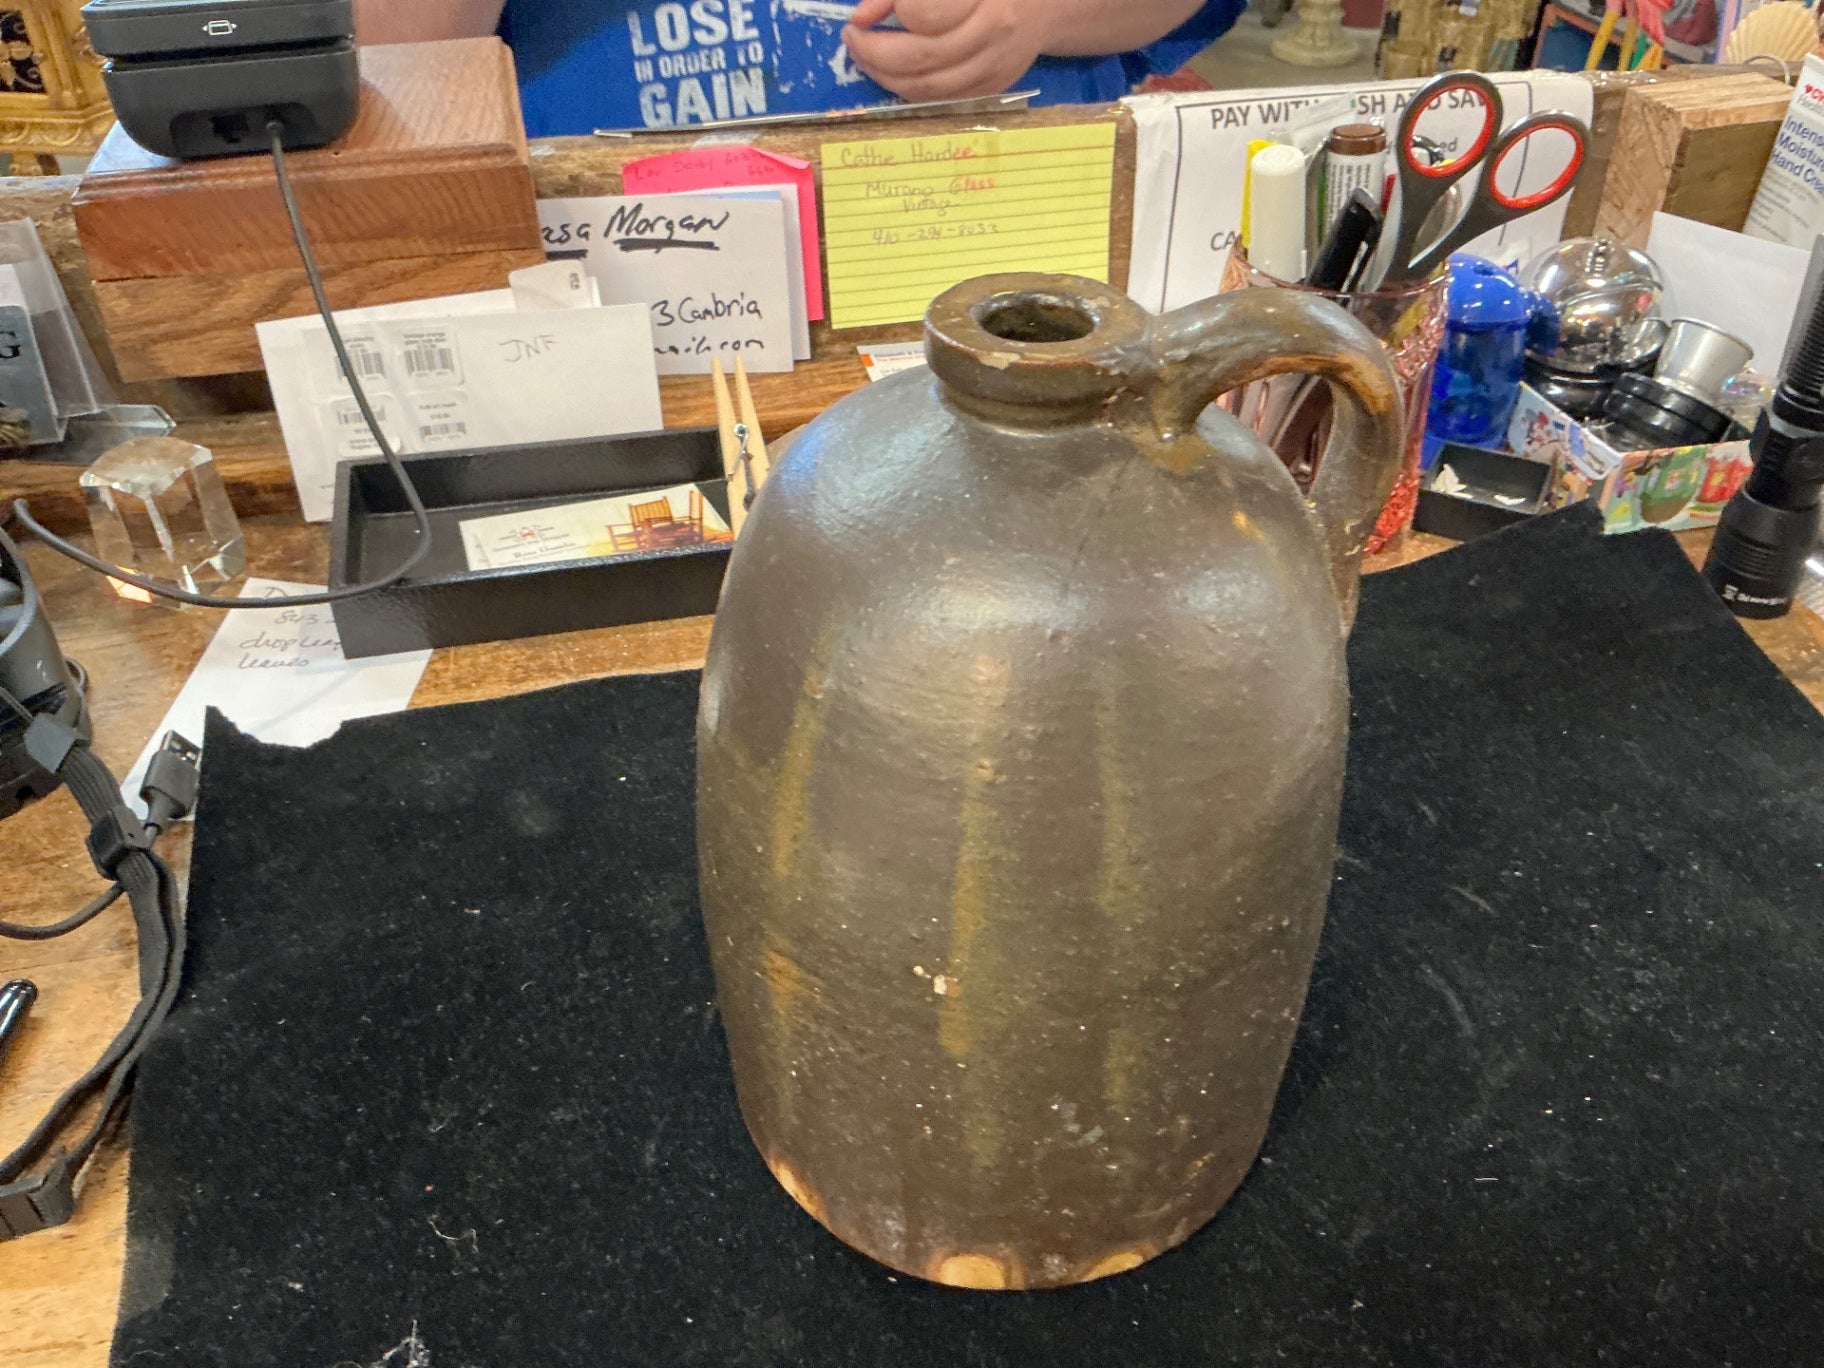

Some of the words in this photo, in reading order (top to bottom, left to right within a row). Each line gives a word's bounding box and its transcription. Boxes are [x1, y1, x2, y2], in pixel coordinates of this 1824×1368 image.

[626, 0, 760, 57] LOSE
[633, 58, 654, 83] IN
[658, 47, 727, 79] ORDER
[736, 41, 764, 67] TO
[639, 66, 768, 129] GAIN
[1211, 106, 1250, 130] PAY
[1257, 99, 1319, 123] WIT
[1393, 90, 1441, 114] AD
[603, 202, 730, 241] Morgan
